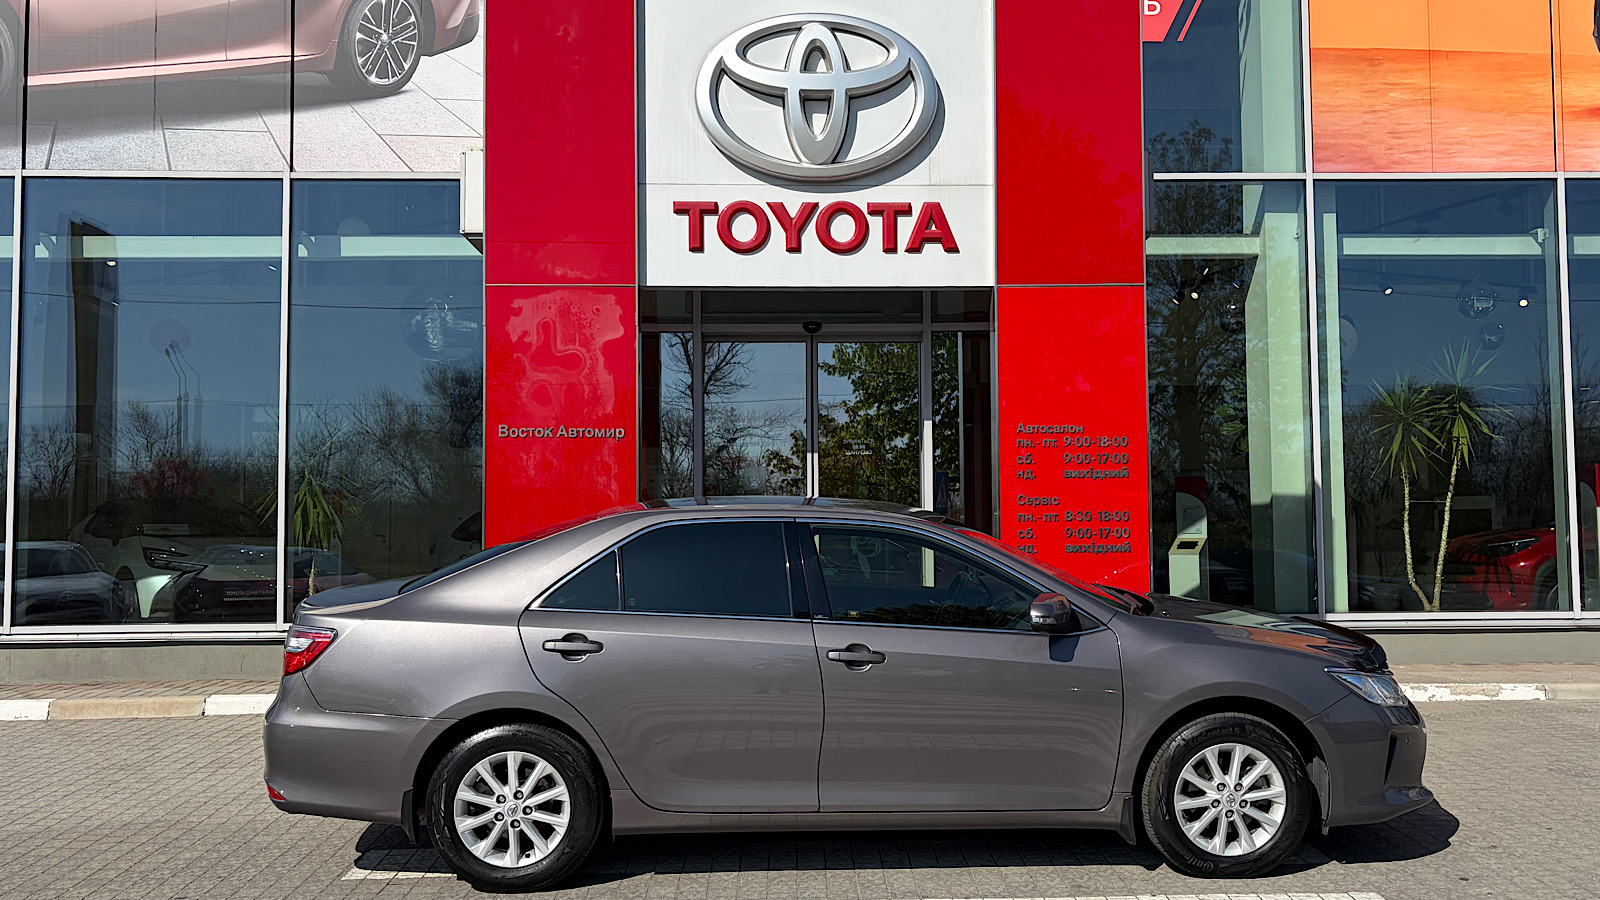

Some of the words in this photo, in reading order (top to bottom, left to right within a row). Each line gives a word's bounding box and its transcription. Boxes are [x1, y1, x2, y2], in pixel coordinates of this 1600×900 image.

[673, 200, 960, 255] TOYOTA
[498, 424, 554, 438] Восток
[556, 424, 625, 442] Автомир
[1016, 422, 1084, 434] Автосалон
[1063, 436, 1129, 448] 9:00-18:00
[1016, 453, 1036, 465] сб.
[1063, 453, 1129, 465] 9:00-17:00
[1016, 469, 1037, 480] нд.
[1063, 466, 1130, 480] вихідний
[1017, 494, 1060, 508] Сервіс
[1018, 528, 1037, 540] сб.
[1064, 528, 1131, 540] 9:00-17:00
[1065, 541, 1132, 555] вихідний
